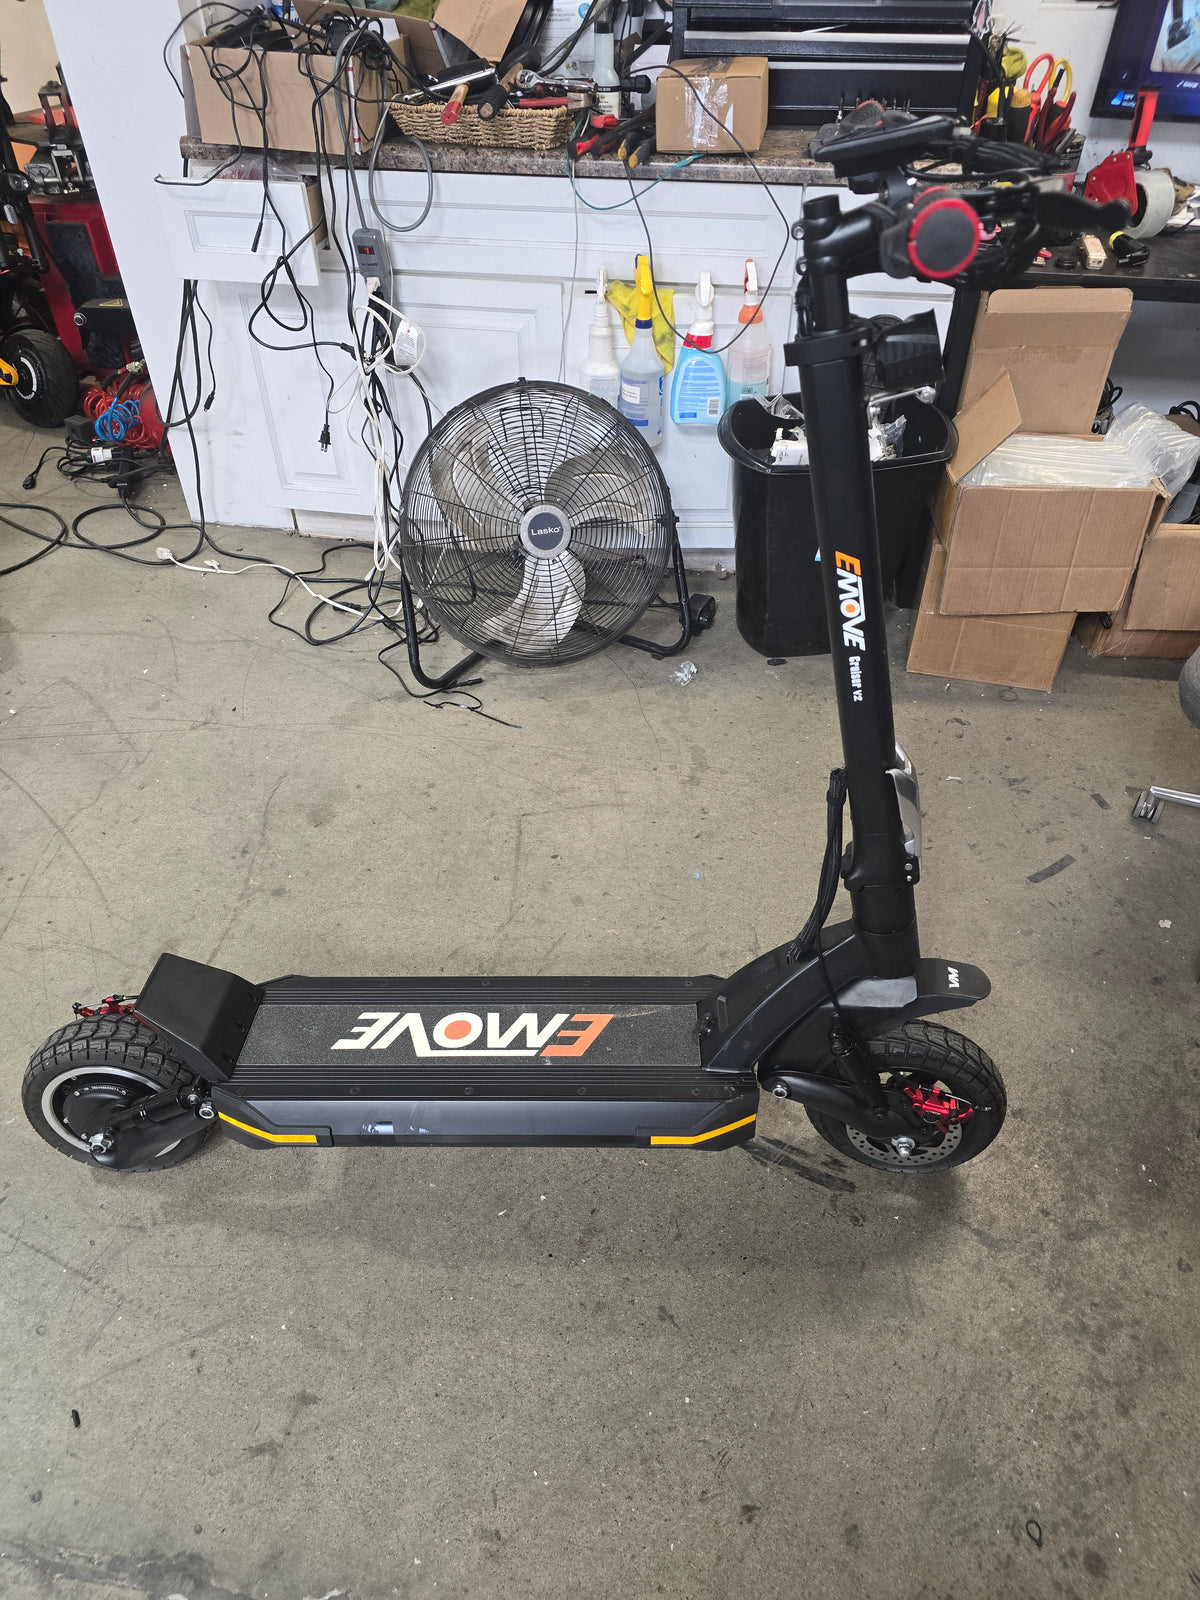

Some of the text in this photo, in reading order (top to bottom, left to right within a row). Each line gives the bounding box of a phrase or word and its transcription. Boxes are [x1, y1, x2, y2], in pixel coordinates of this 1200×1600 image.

[531, 526, 560, 536] Lasko
[834, 550, 866, 651] EMOVE
[848, 655, 863, 689] Cruiser
[330, 1011, 615, 1058] EMOVE
